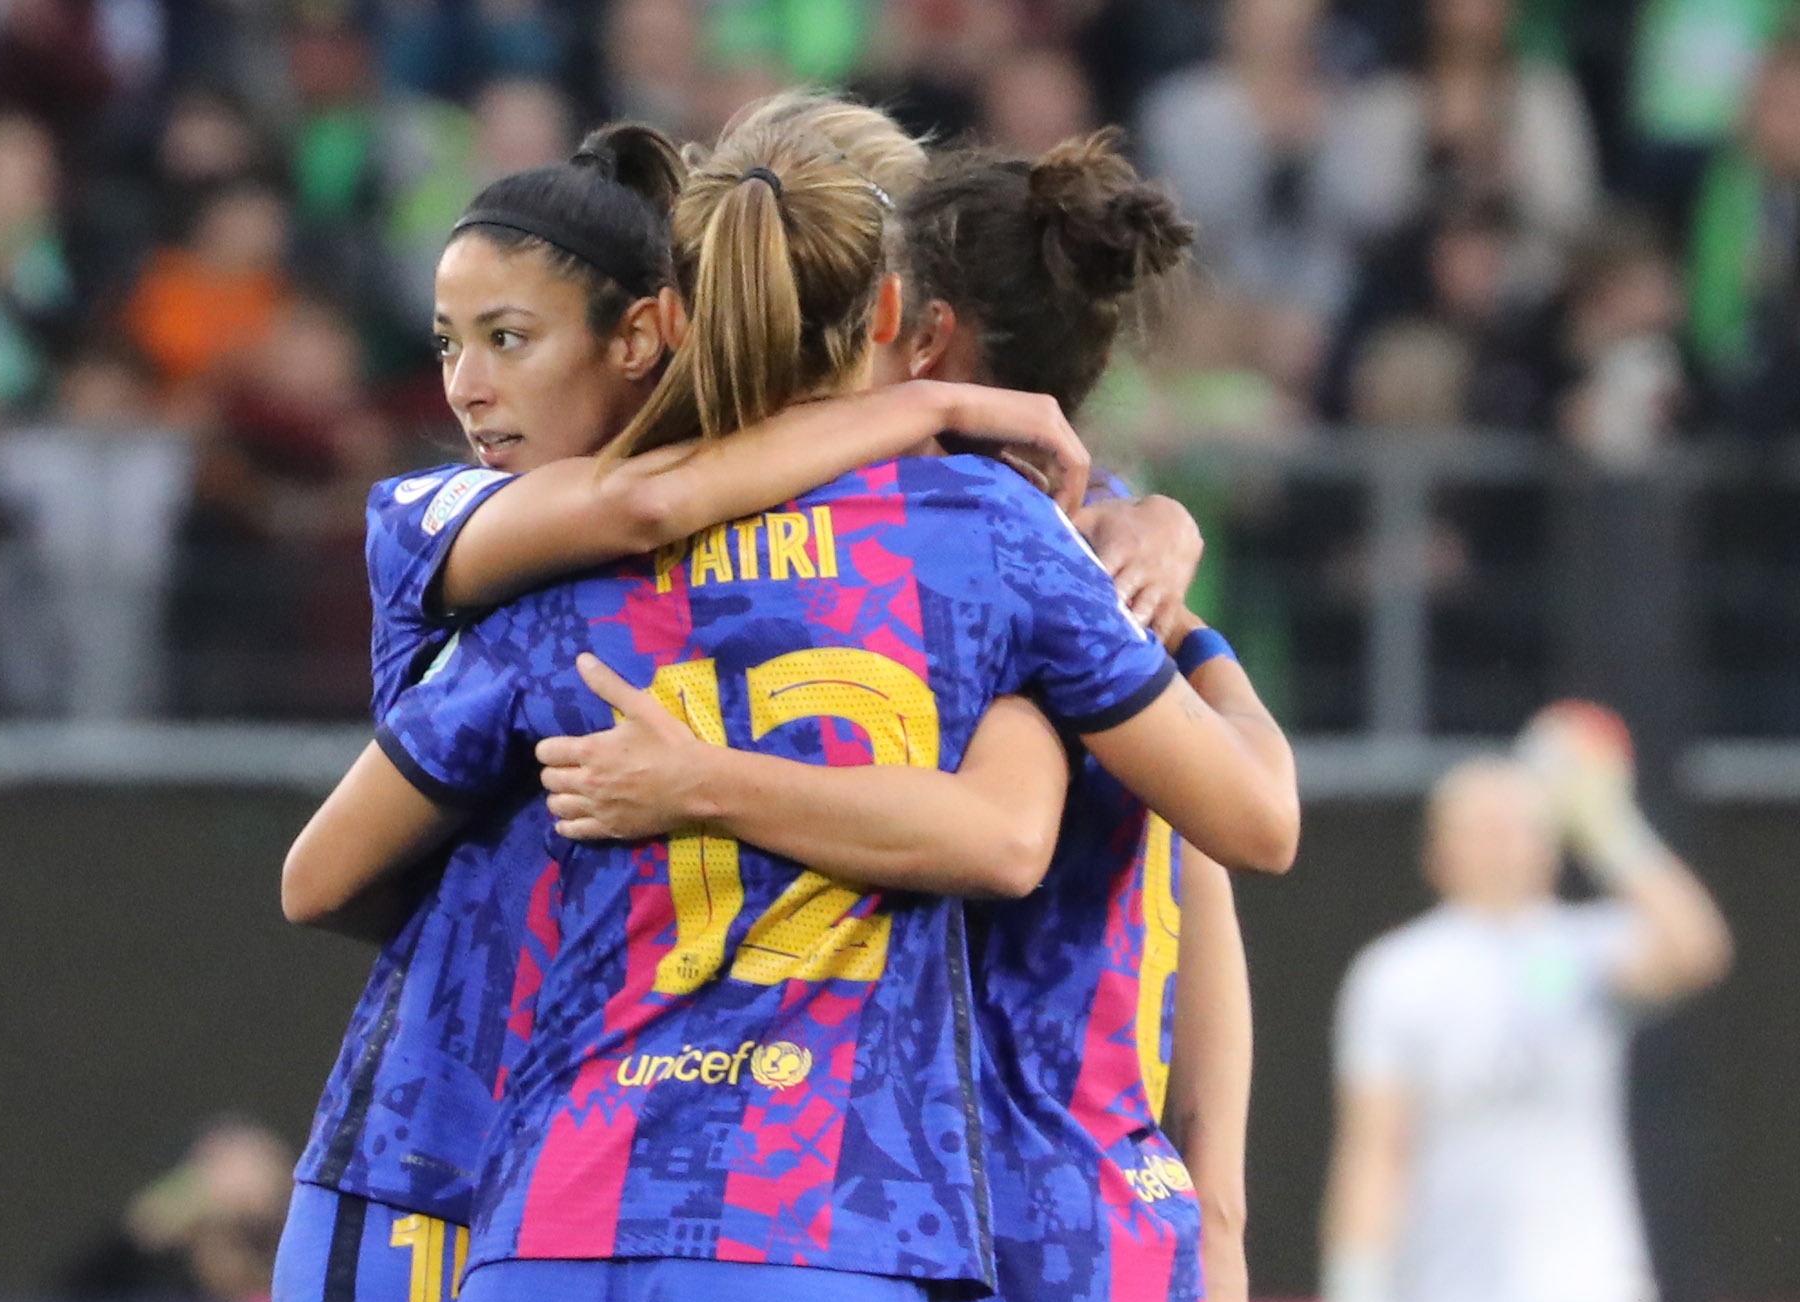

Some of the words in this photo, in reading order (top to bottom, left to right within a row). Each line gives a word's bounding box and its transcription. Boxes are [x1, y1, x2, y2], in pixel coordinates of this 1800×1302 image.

[654, 506, 838, 594] PATRI
[613, 646, 941, 995] 12
[616, 1040, 756, 1087] unicef
